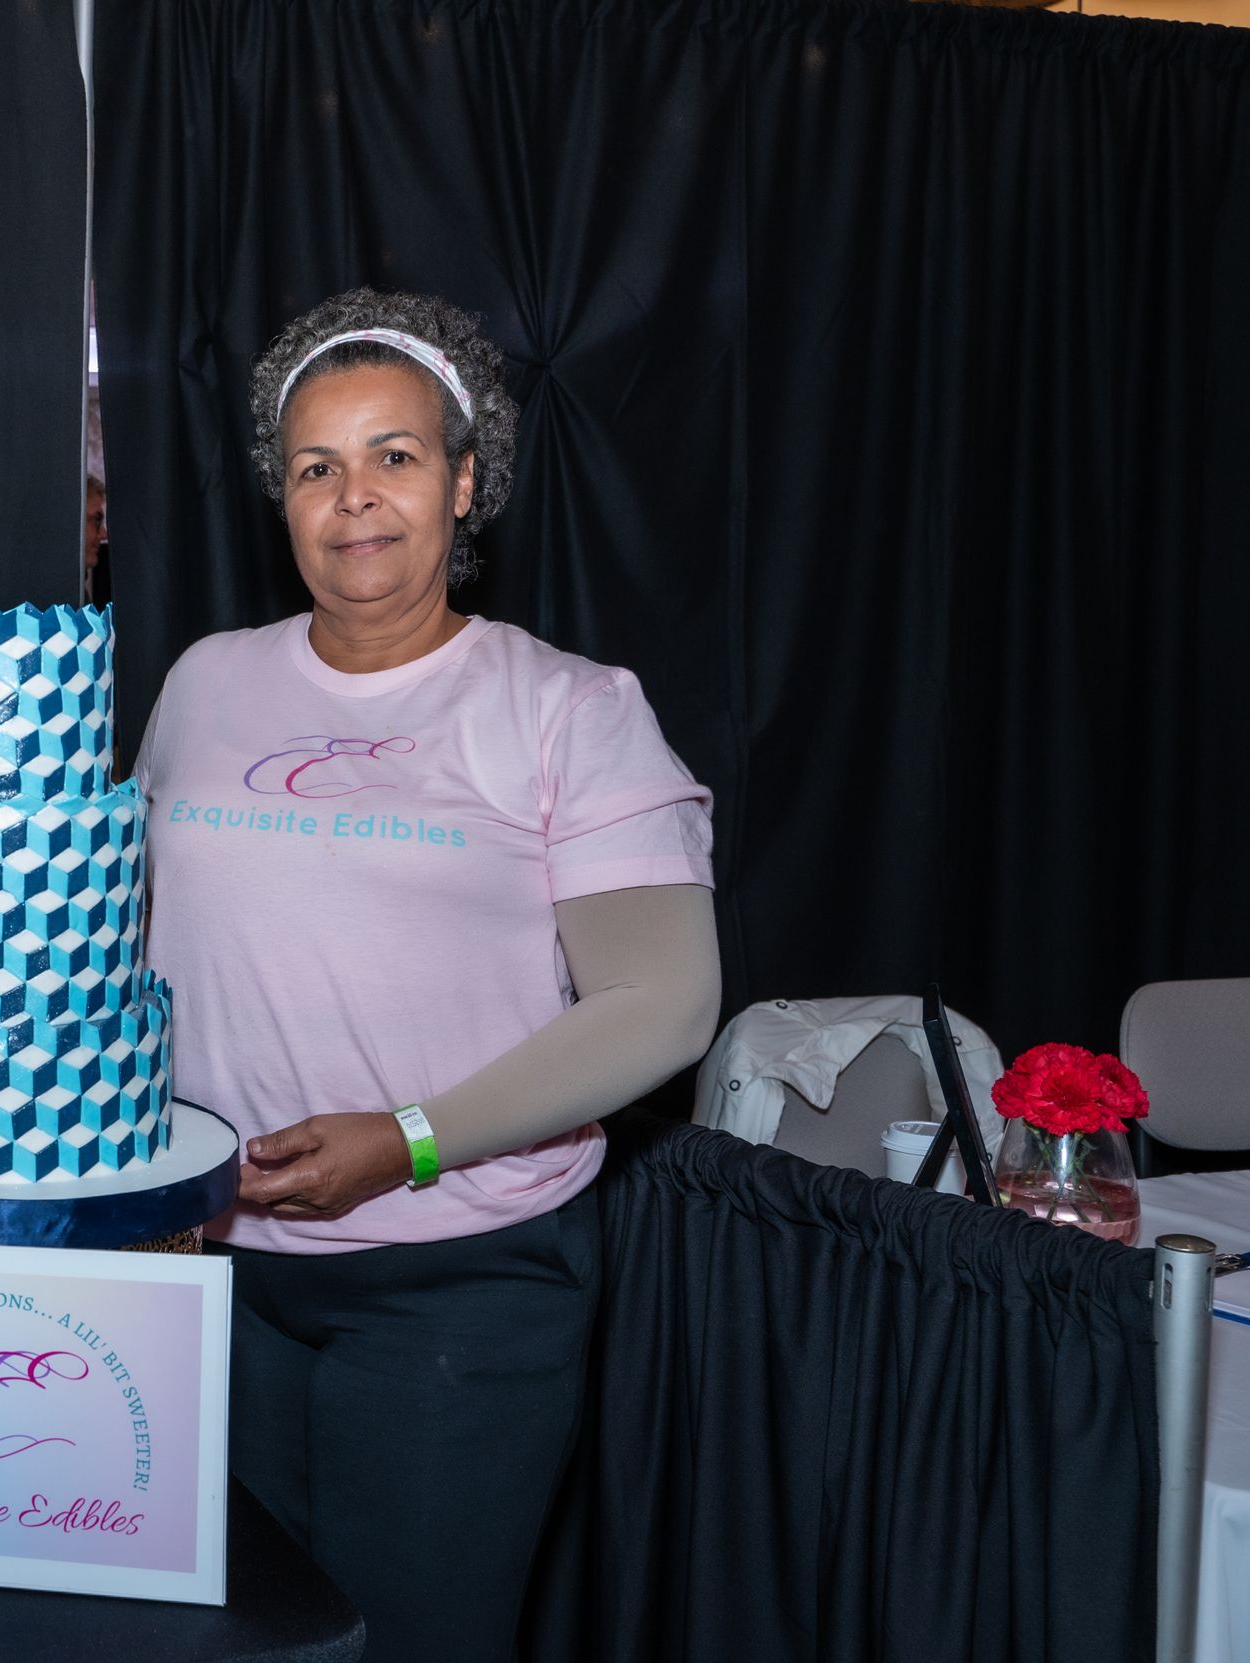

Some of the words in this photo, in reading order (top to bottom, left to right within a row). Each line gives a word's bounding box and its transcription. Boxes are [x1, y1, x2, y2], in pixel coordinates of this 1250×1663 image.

[168, 800, 318, 835] Exquisite
[333, 812, 467, 848] Edibles
[57, 1313, 71, 1329] A
[73, 1321, 107, 1351] LIL'
[102, 1350, 131, 1384] BIT
[122, 1386, 151, 1492] SWEETER!
[18, 1494, 146, 1536] Edibles
